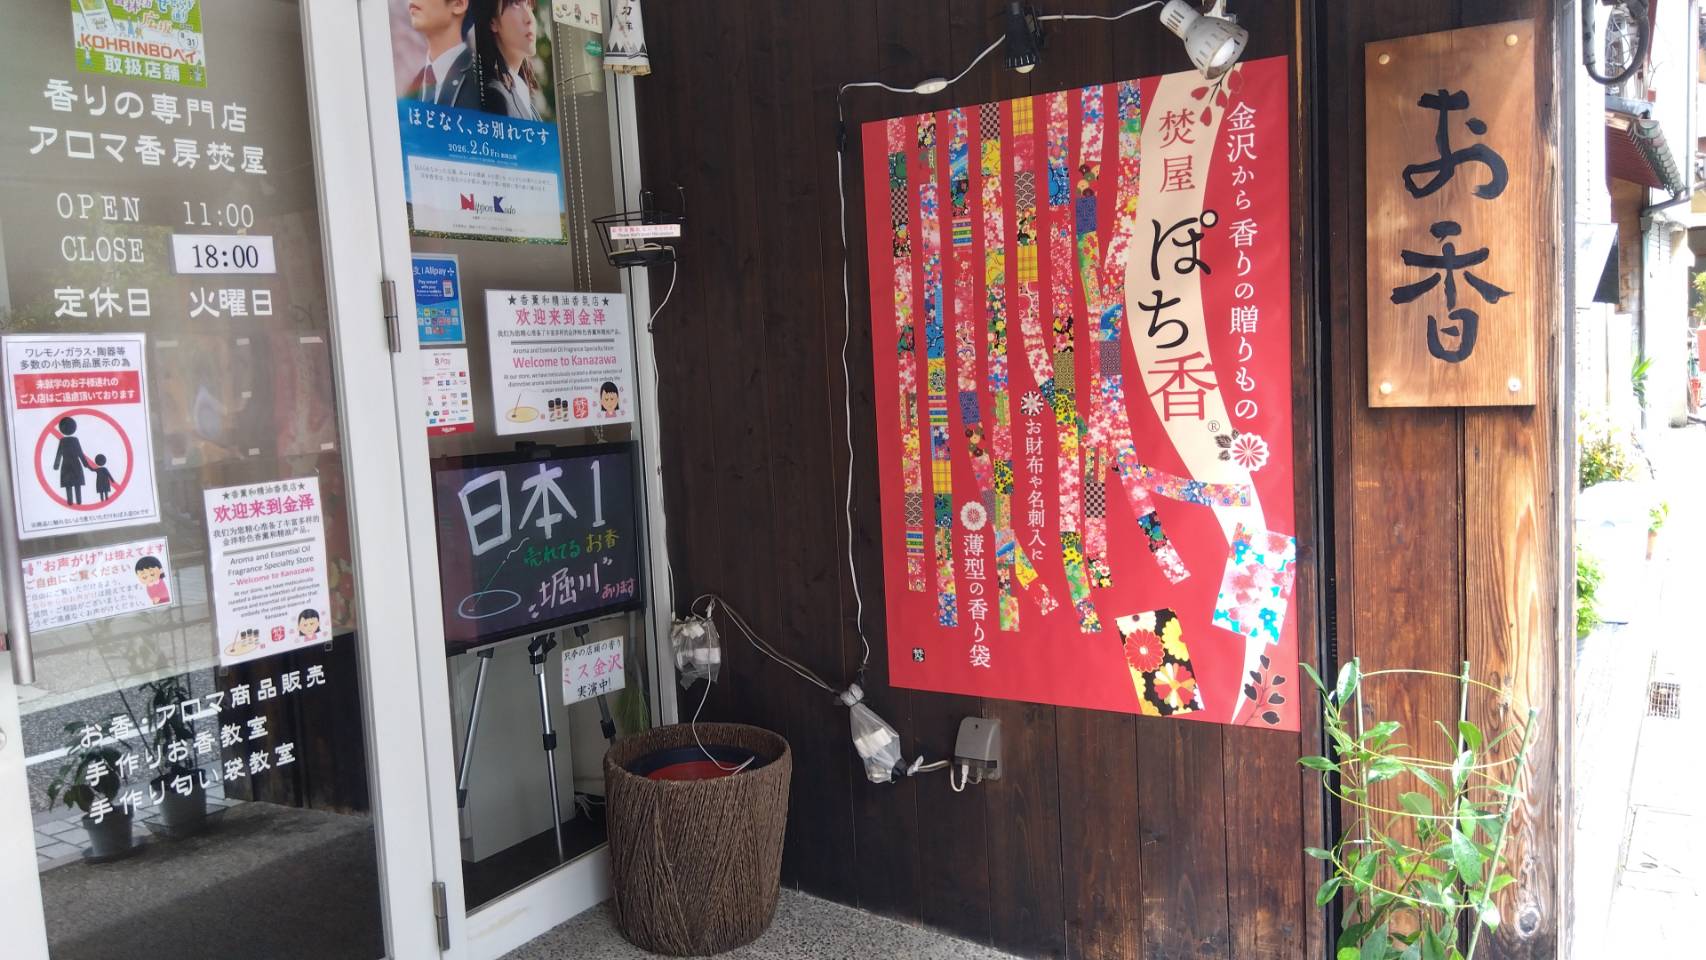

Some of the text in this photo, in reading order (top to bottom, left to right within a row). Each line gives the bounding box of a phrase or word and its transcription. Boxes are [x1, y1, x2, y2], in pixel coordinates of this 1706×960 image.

[104, 54, 181, 82] 取扱店舗
[43, 78, 248, 133] 香りの専門店
[408, 107, 550, 146] ほどなく、お別れです
[29, 125, 268, 175] アロマ香房焚屋
[56, 191, 255, 228] OPEN 11:00
[1390, 88, 1515, 364] お香
[61, 236, 260, 269] CLOSE 18:00
[1137, 107, 1219, 423] 焚屋 ぽち香
[1226, 101, 1259, 420] 金沢から香りの贈りもの
[54, 286, 273, 318] 定休日 火曜日
[516, 308, 606, 326] 欢迎来到金泽
[513, 354, 617, 368] Welcome to Kanazawa
[213, 493, 315, 524] 欢迎来到金泽
[1024, 419, 1047, 561] お財布や名刺入に
[227, 556, 314, 577] Fragrance Specialty Store
[230, 556, 255, 566] Aroma
[256, 553, 269, 562] and
[270, 547, 301, 559] Essential
[524, 528, 620, 567] 売れてる お香
[602, 577, 636, 600] あります
[963, 533, 992, 669] 薄型の香り袋
[563, 653, 623, 685] ミス金沢
[79, 664, 326, 751] お香・アロマ商品販売
[84, 715, 269, 788] 手作りお香教室
[88, 741, 296, 825] 手作り匂い袋教室
